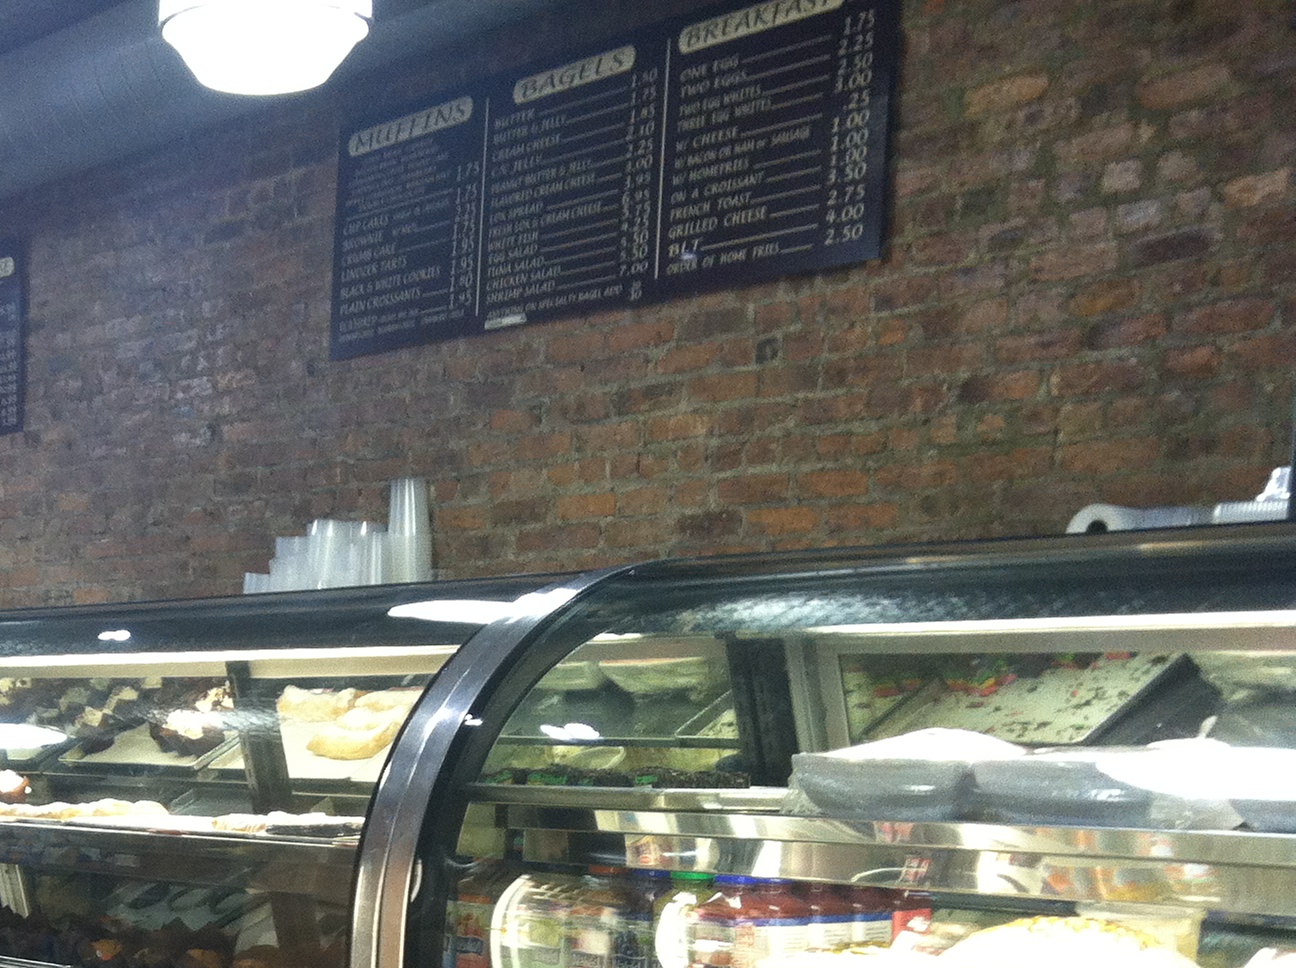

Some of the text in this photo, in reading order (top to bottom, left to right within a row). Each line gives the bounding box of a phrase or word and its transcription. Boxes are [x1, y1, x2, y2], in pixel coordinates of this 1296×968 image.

[679, 64, 707, 82] ONE
[843, 9, 875, 35] 1.75
[522, 53, 626, 99] BAGELS
[680, 80, 710, 98] TWO
[723, 84, 762, 106] WHITES
[354, 103, 465, 153] MUFFINS
[494, 107, 536, 131] BUTTER
[831, 108, 870, 133] 1.00
[491, 142, 525, 162] CREAM
[526, 133, 562, 155] CHEESE
[493, 124, 529, 145] BUTTER
[692, 126, 738, 149] CHEESE
[830, 127, 869, 151] 1.00
[512, 153, 544, 176] JELLY
[670, 188, 687, 205] ON
[691, 187, 700, 199] A
[703, 170, 765, 197] CROISSANT
[667, 183, 866, 240] GRILLED CHEESE 2.75
[669, 200, 712, 222] FRENCH
[717, 190, 753, 211] TOAST
[824, 202, 865, 223] 4.00
[373, 241, 397, 260] CAKE
[507, 242, 539, 261] SALAD
[719, 247, 747, 265] HOME
[751, 241, 780, 260] FRIES
[824, 223, 864, 246] 2.50
[375, 273, 402, 291] WHITE
[403, 264, 442, 285] COOKIES
[485, 273, 528, 293] CHICKEN
[530, 264, 562, 283] SALAD
[487, 262, 512, 279] TUNA
[514, 254, 545, 273] SALAD
[485, 260, 650, 305] SHRIMP SALAD 7.00
[339, 298, 365, 316] PLAIN
[366, 286, 422, 310] CROISSANTS
